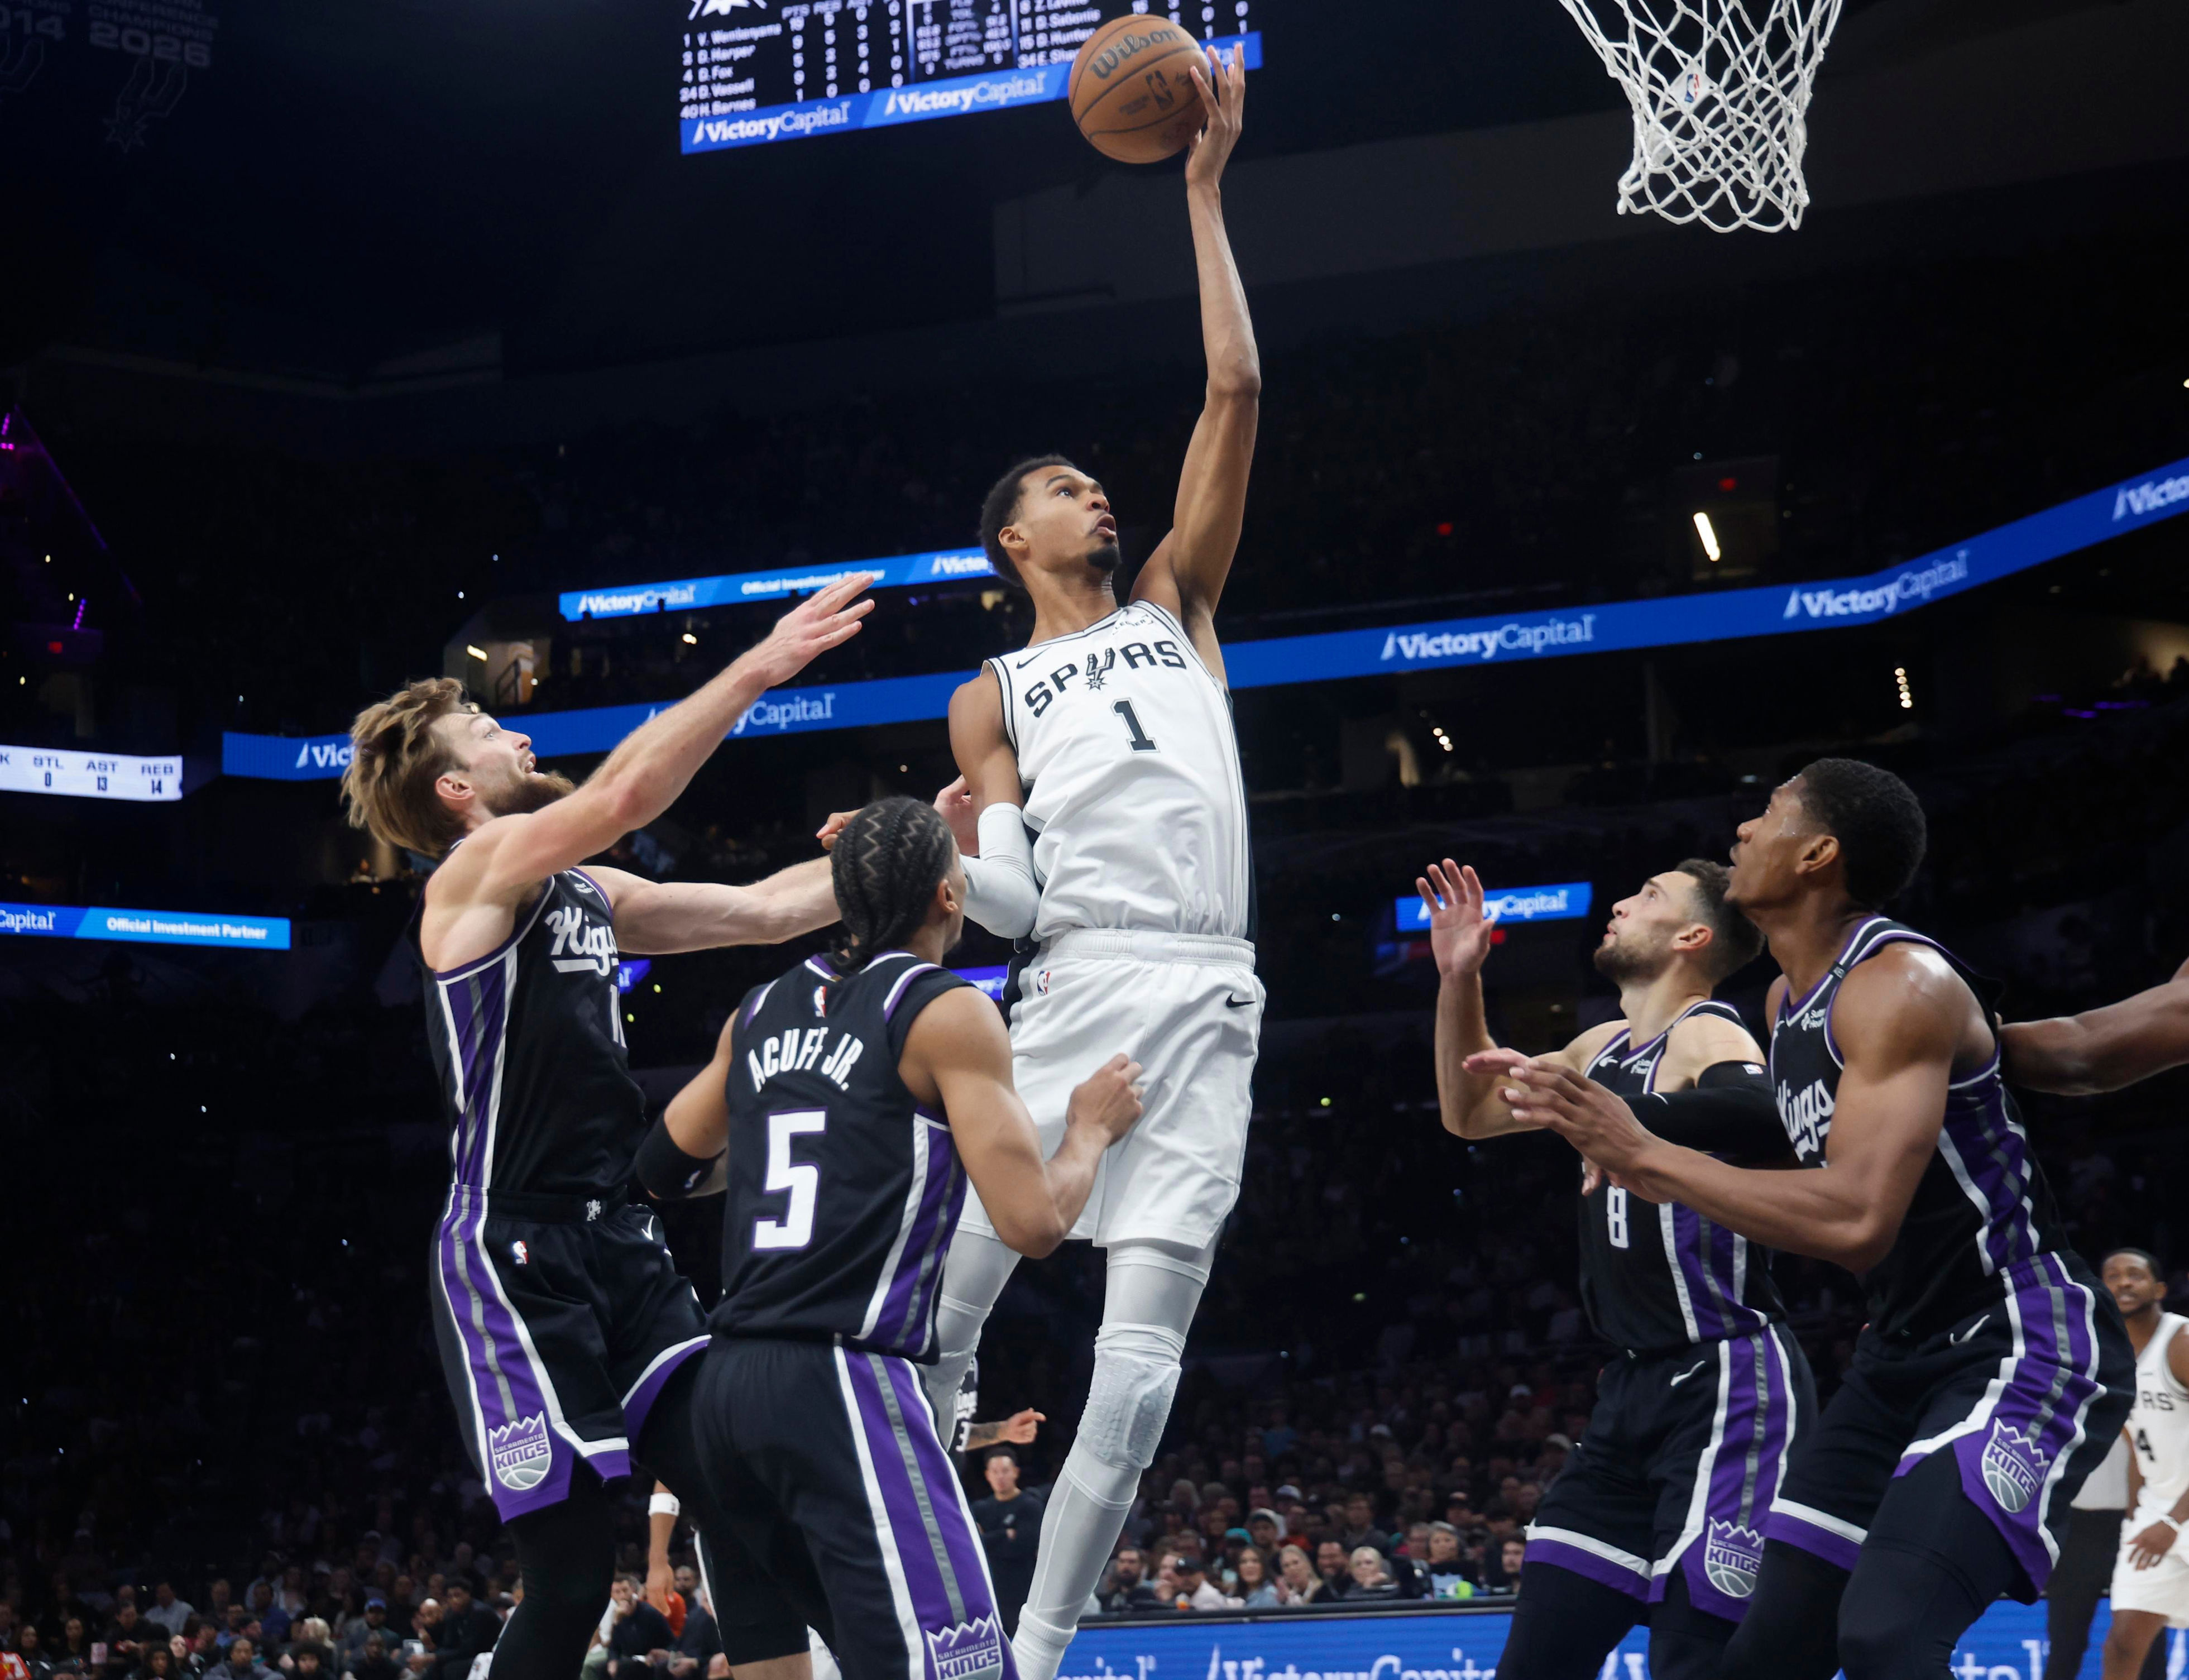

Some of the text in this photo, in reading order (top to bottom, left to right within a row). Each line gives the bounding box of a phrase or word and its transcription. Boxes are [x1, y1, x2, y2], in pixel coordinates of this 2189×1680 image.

[89, 20, 211, 69] 2026
[684, 33, 691, 48] 1
[893, 37, 900, 52] 1
[1091, 29, 1181, 79] Wilson
[711, 65, 733, 80] Fox
[796, 88, 803, 103] 1
[741, 577, 780, 595] Official
[1110, 697, 1160, 754] 1
[33, 755, 64, 770] STL
[87, 760, 118, 773] AST
[141, 763, 174, 776] REB
[45, 772, 162, 795] 0 13 14
[107, 916, 267, 940] Official Investment Partner
[748, 1027, 864, 1093] ACUFF JR.
[751, 1106, 827, 1253] 5
[1606, 1185, 1629, 1248] 8
[495, 1433, 544, 1454] SACRAMENTO
[495, 1441, 549, 1470] KINGS
[2136, 1428, 2156, 1462] 4
[938, 1638, 997, 1660] SACRAMENTO
[938, 1648, 1000, 1680] KINGS
